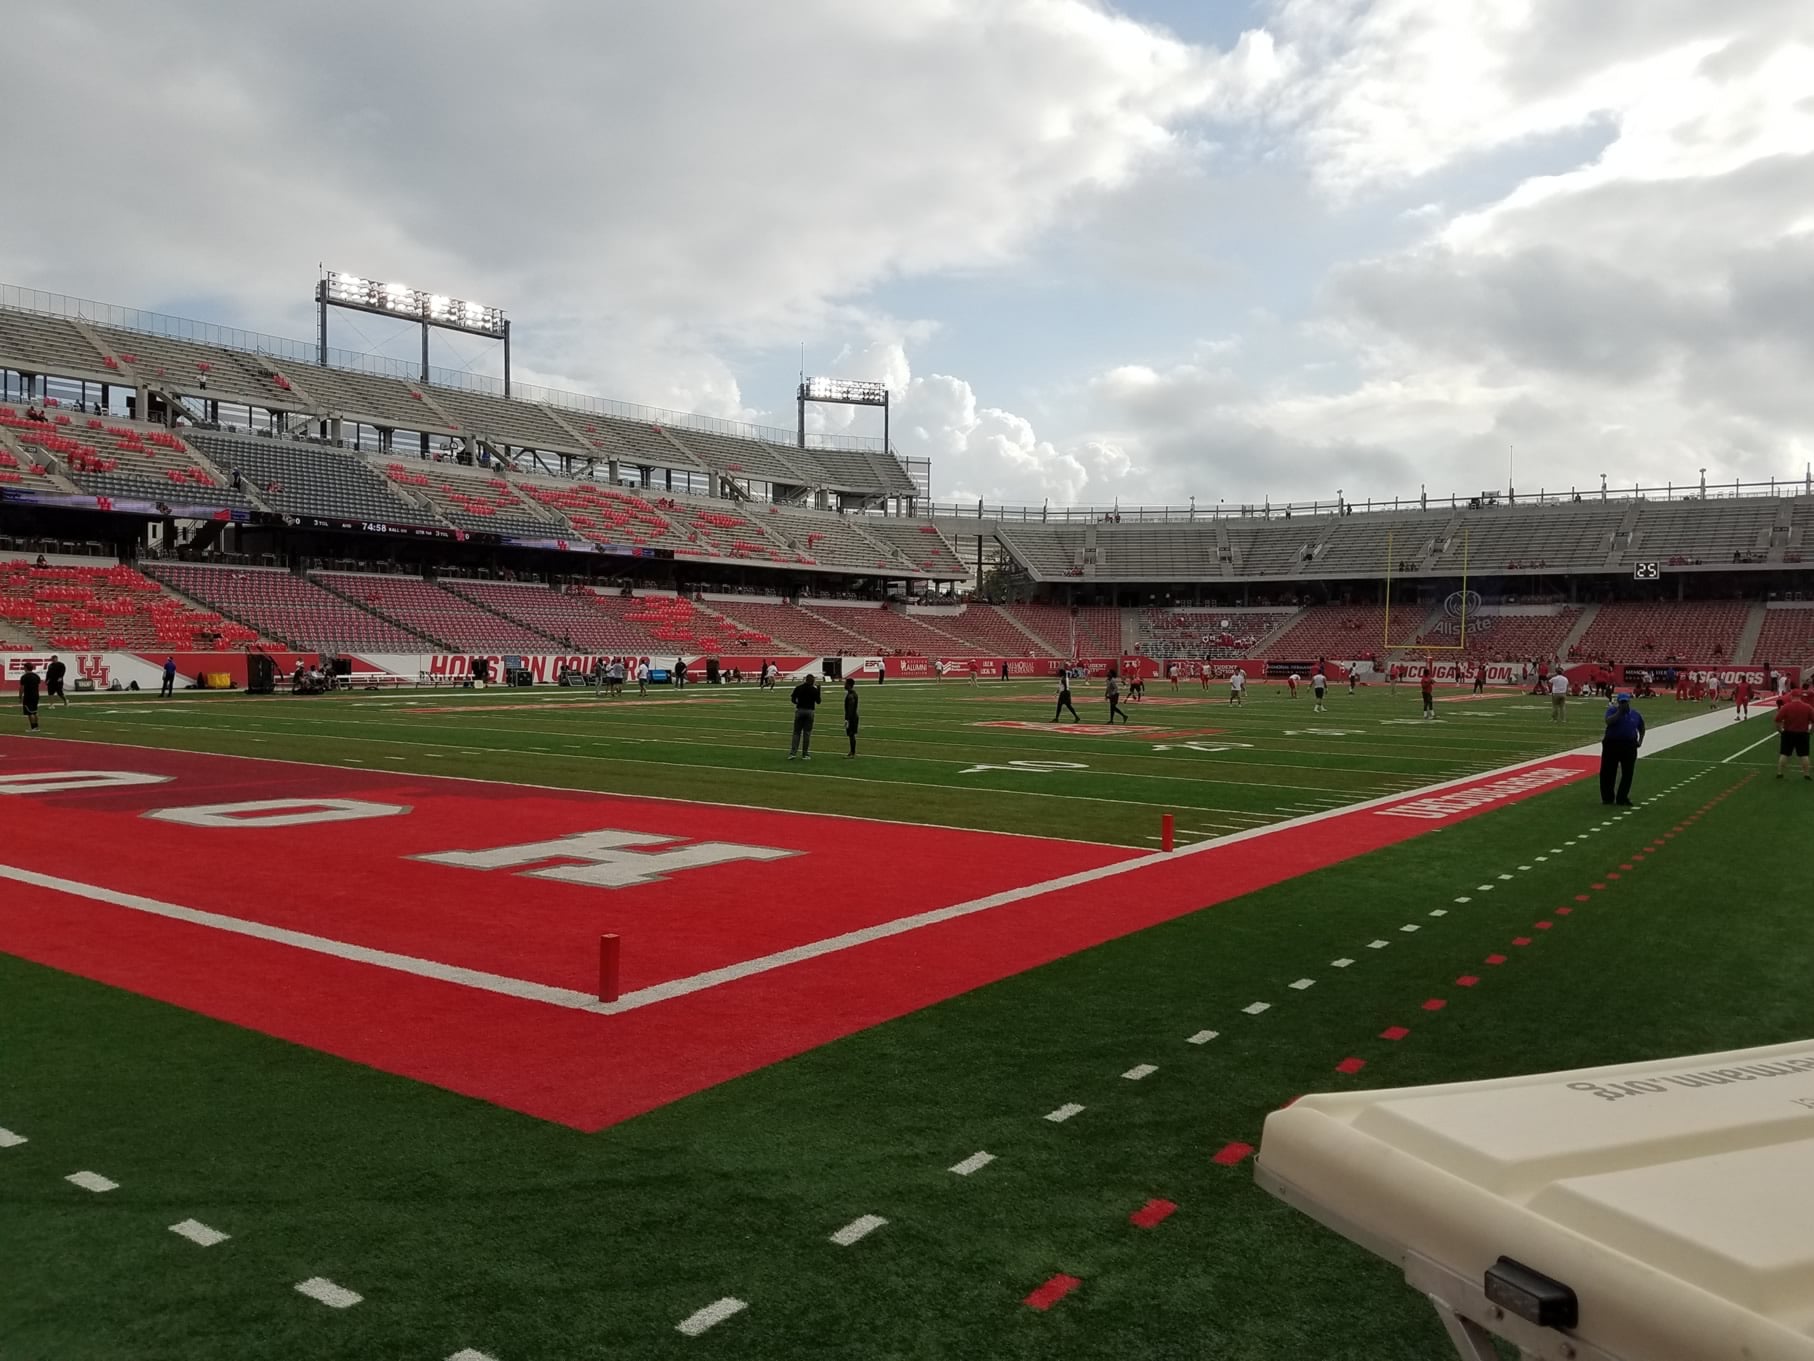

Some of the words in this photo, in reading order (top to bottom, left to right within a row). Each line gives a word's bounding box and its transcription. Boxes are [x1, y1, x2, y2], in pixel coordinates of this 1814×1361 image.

[361, 522, 387, 532] 74:58
[1636, 563, 1657, 577] 25
[1432, 618, 1491, 635] Allsate
[8, 658, 52, 671] ESP
[430, 655, 547, 683] HOSN
[552, 656, 650, 682] COUR
[1566, 1056, 1814, 1102] ermann.org
